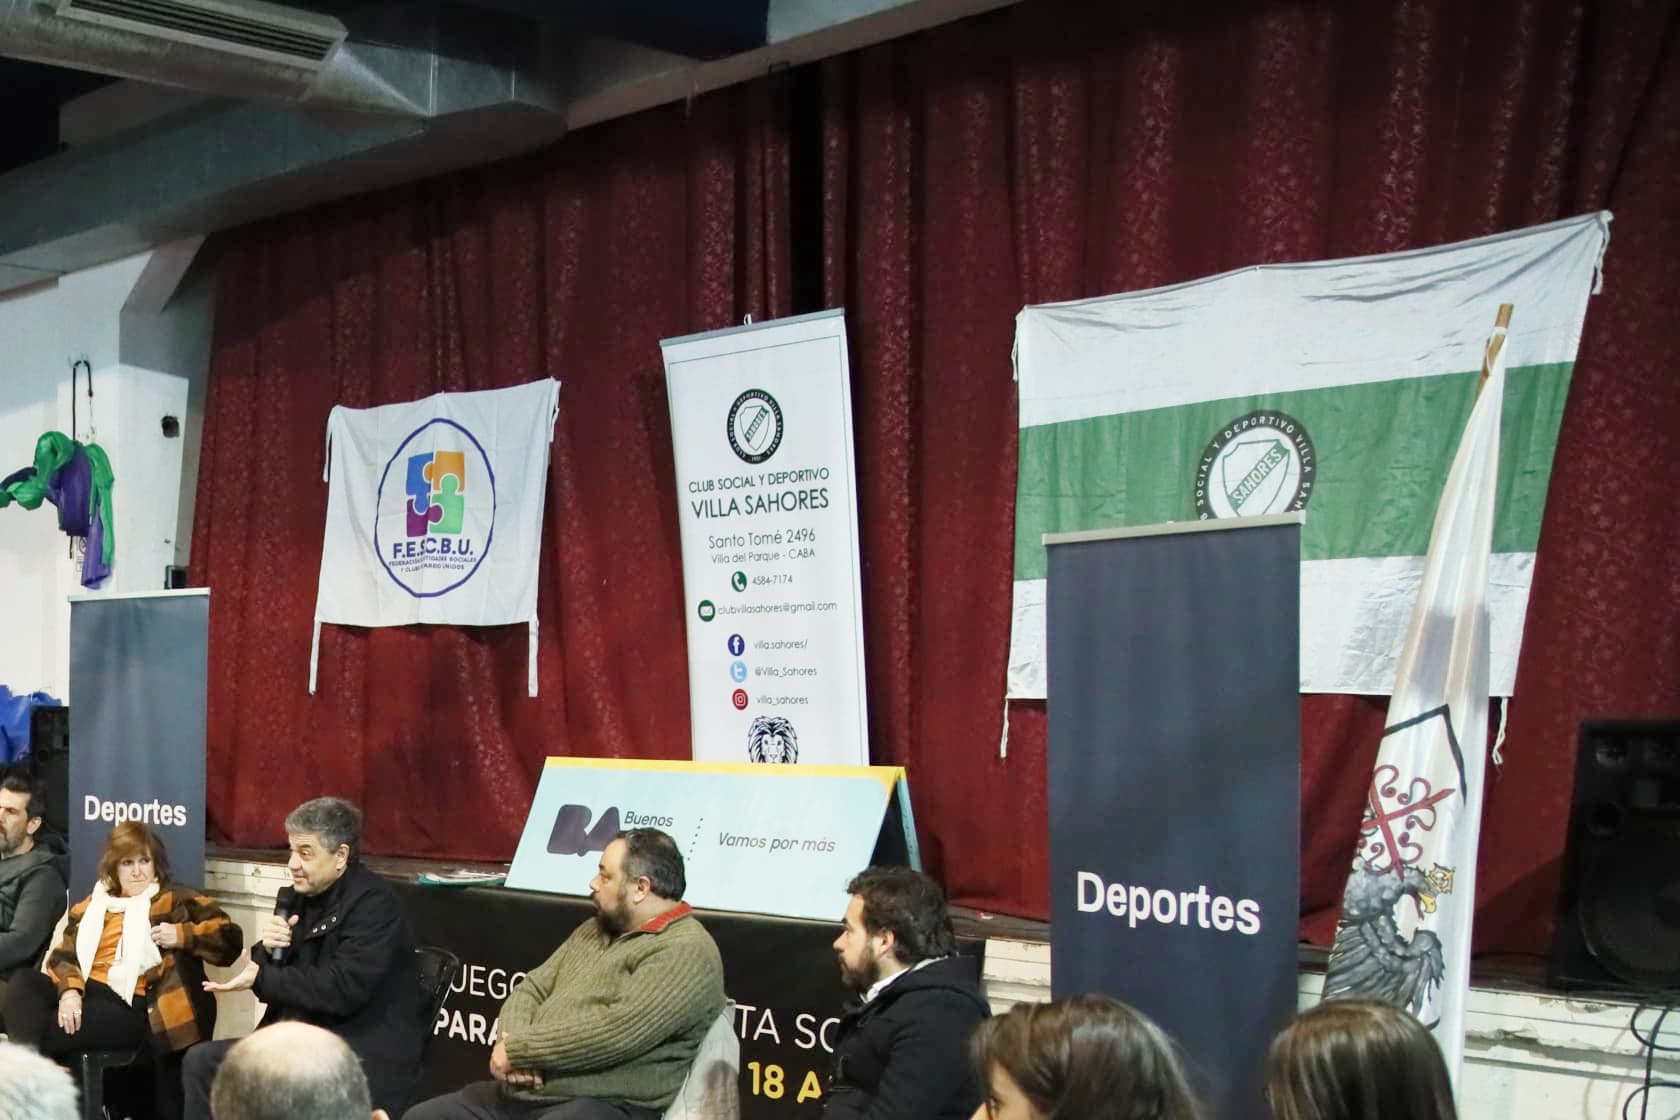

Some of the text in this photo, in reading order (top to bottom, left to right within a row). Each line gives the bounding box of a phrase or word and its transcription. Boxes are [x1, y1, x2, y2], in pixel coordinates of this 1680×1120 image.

[1224, 416, 1295, 440] DEPORTIVO
[1295, 434, 1312, 473] VILLA
[688, 467, 830, 493] CLUB SOCIAL Y DEPORTIVO
[1231, 447, 1283, 505] SAHORES
[691, 488, 829, 519] VILLA SAHORES
[708, 528, 816, 549] Santo Tomé 2496
[711, 553, 730, 564] Villa
[732, 552, 746, 563] del
[748, 551, 780, 563] Parque
[788, 547, 815, 559] CABA
[84, 795, 187, 827] Deportes
[624, 810, 674, 828] Buenos
[719, 831, 836, 854] Vamos por más
[1077, 871, 1261, 935] Deportes
[735, 1004, 780, 1044] TA
[747, 1061, 785, 1099] 18
